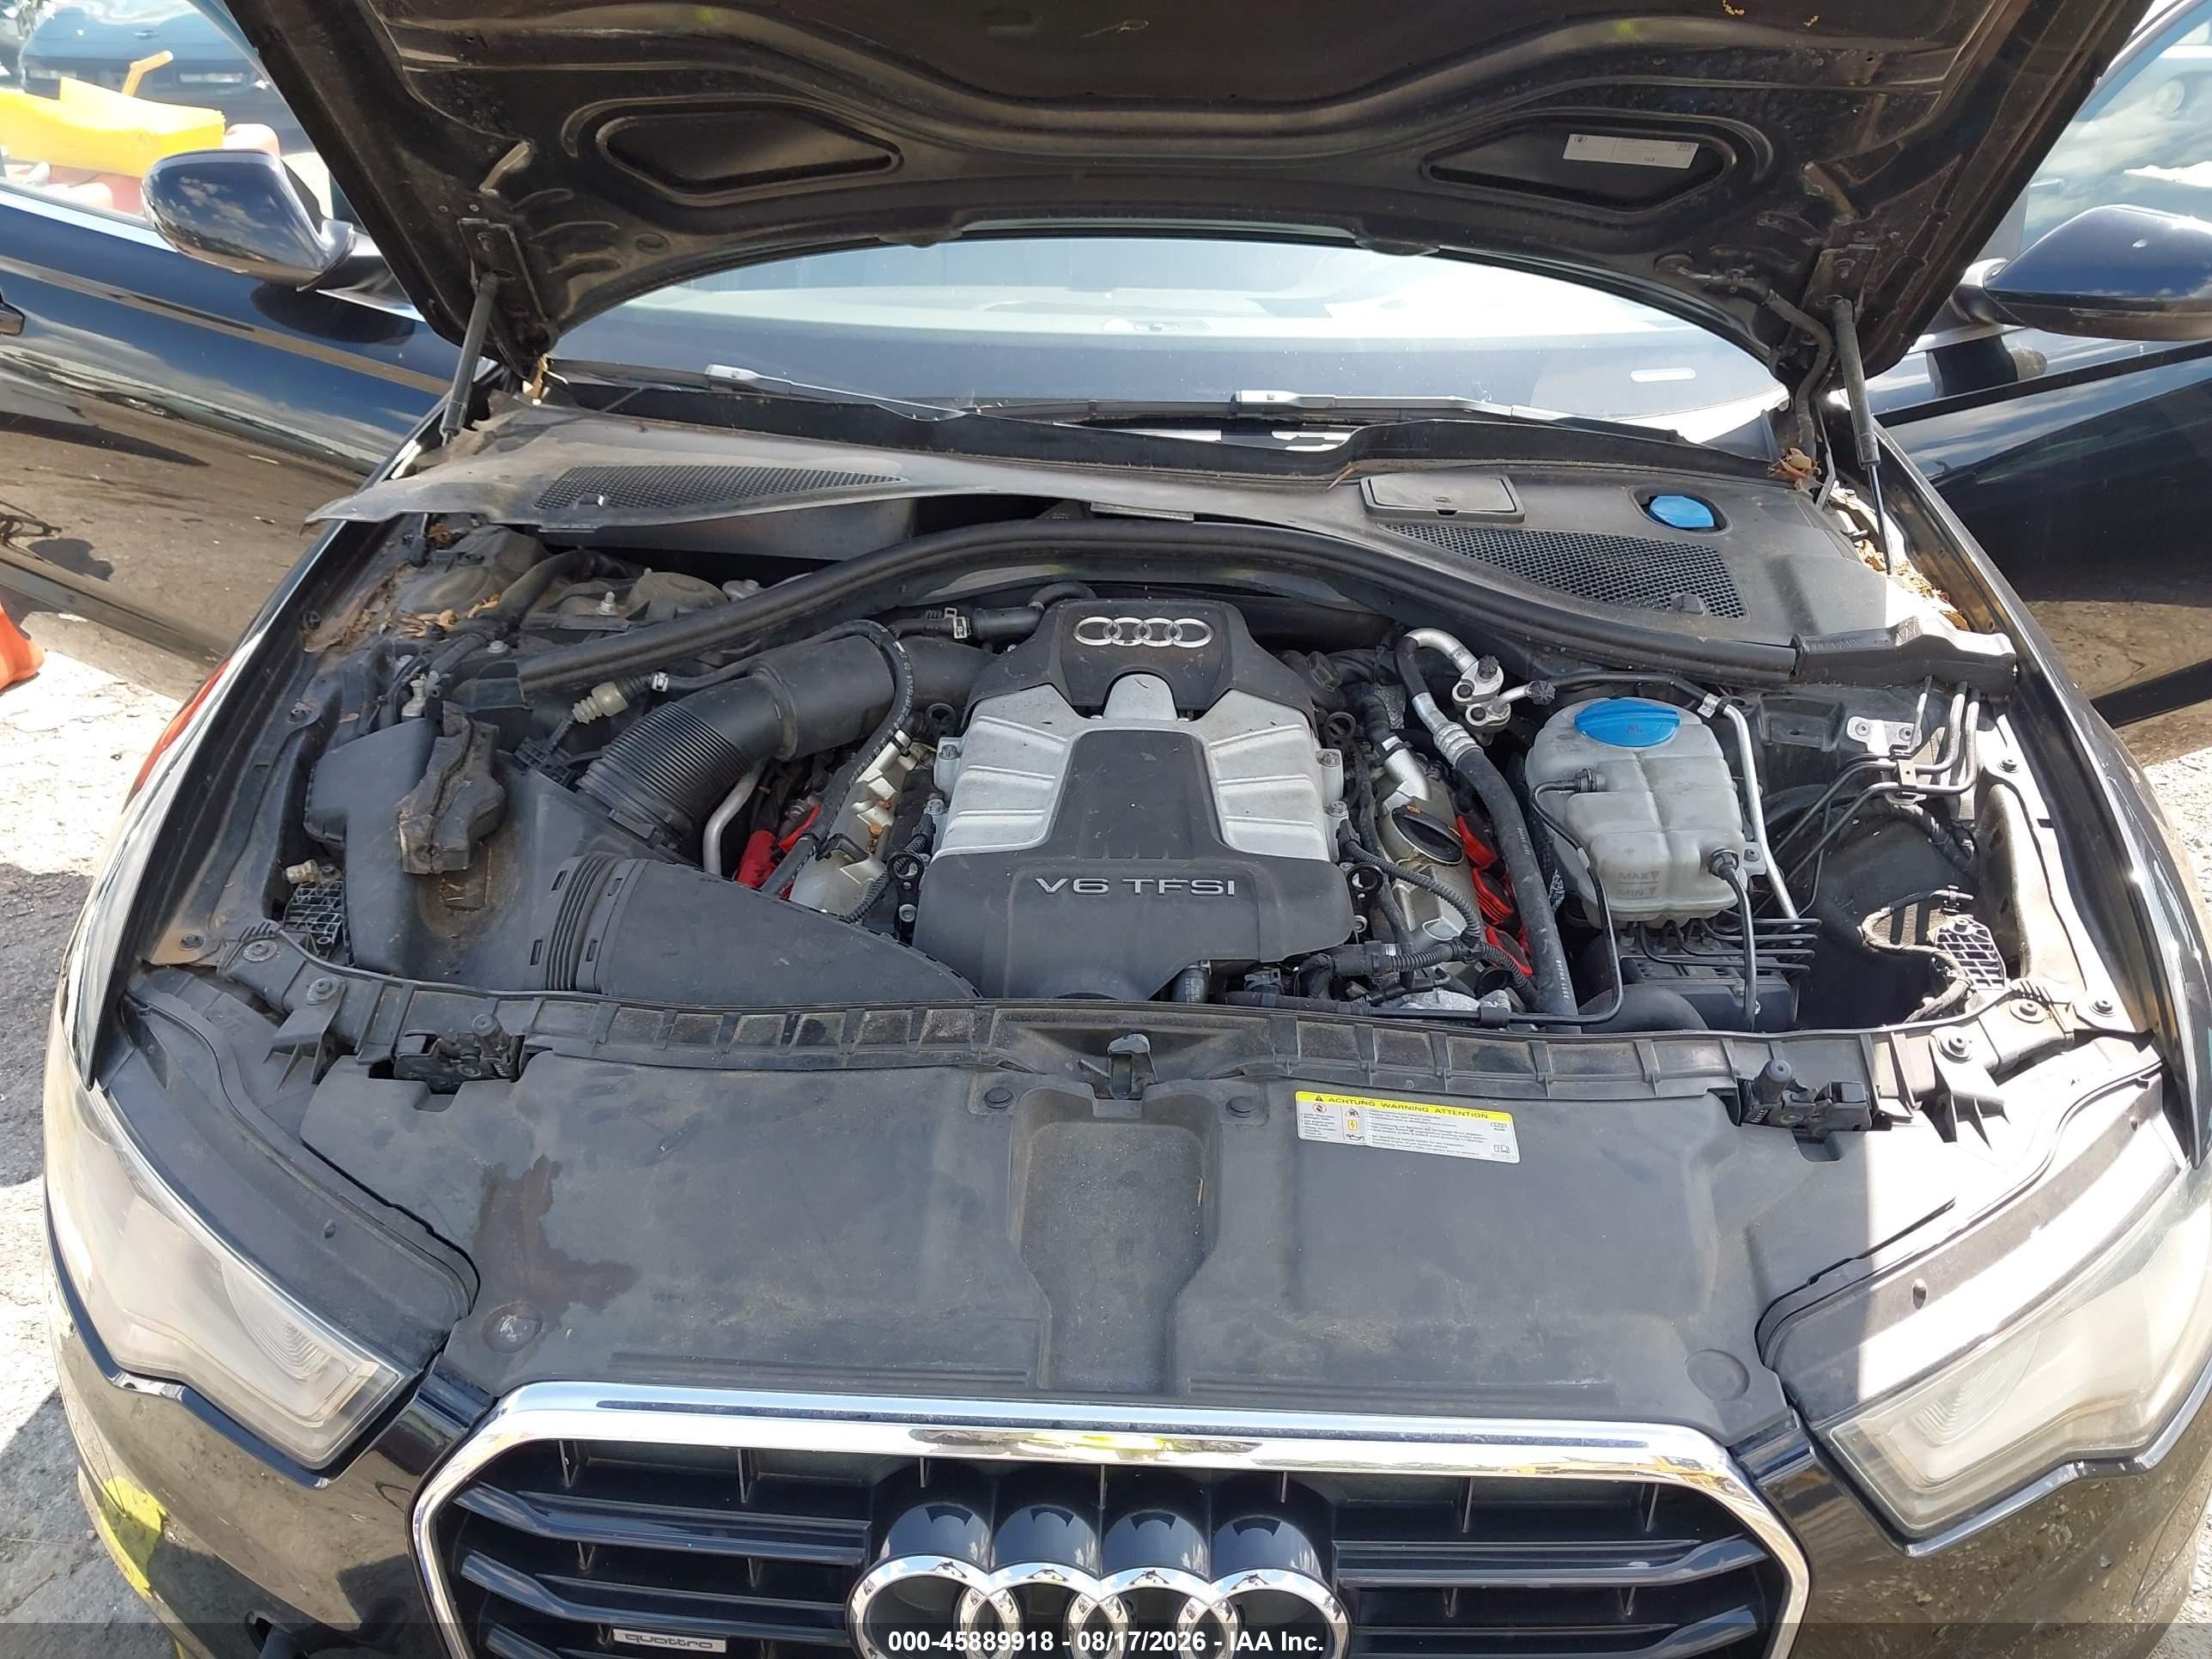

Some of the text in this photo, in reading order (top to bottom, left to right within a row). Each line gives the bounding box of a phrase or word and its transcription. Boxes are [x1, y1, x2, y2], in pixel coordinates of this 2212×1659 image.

[1618, 872, 1649, 880] MAX
[1035, 878, 1235, 896] V6 TFSI
[1328, 1097, 1488, 1119] ACHTUNG WARNING ATTENTION
[624, 1633, 713, 1649] quattro
